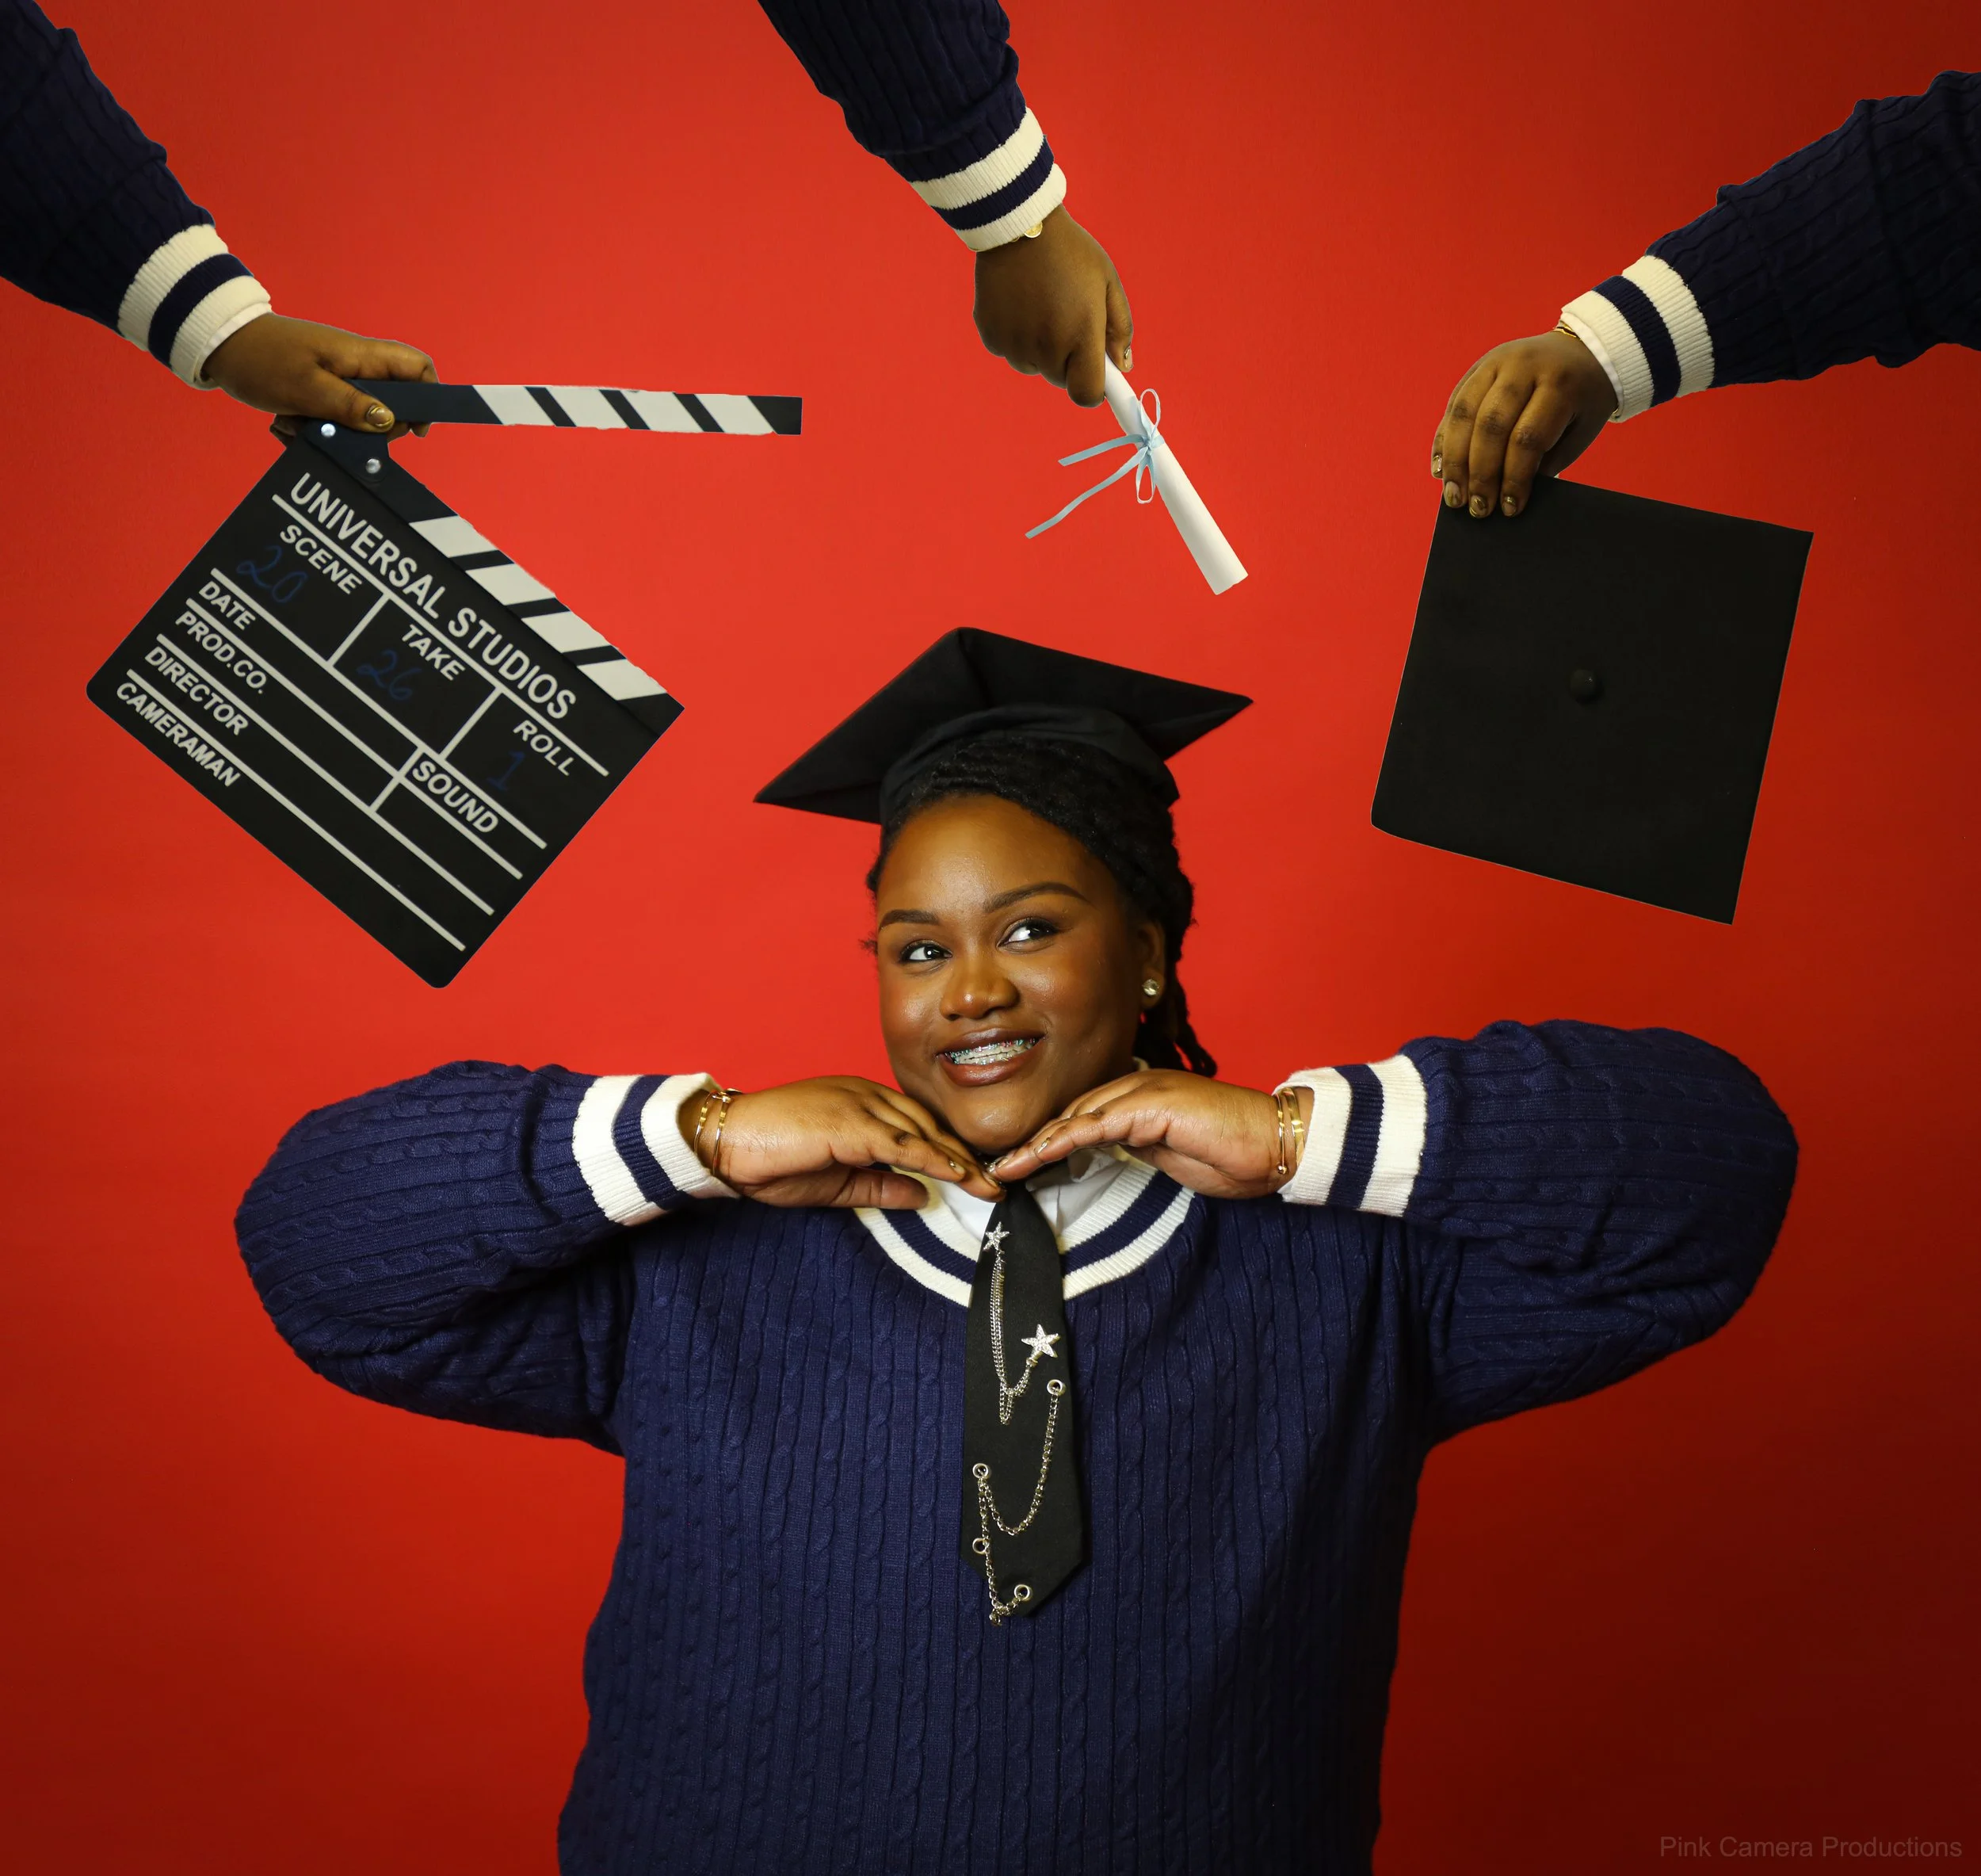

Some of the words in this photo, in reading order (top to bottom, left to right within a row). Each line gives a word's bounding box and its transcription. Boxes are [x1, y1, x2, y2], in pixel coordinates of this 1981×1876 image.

[237, 546, 307, 602] 20
[280, 525, 363, 594] SCENE
[198, 580, 256, 630] DATE
[290, 472, 446, 620] UNIVERSAL
[447, 607, 577, 720] STUDIOS
[175, 611, 267, 694] PROD.CO.
[357, 649, 422, 701] 26
[401, 624, 466, 681] TAKE
[144, 646, 249, 735] DIRECTOR
[116, 682, 241, 787] CAMERAMAN
[513, 720, 574, 776] ROLL
[412, 760, 498, 833] SOUND
[486, 751, 525, 791] 1
